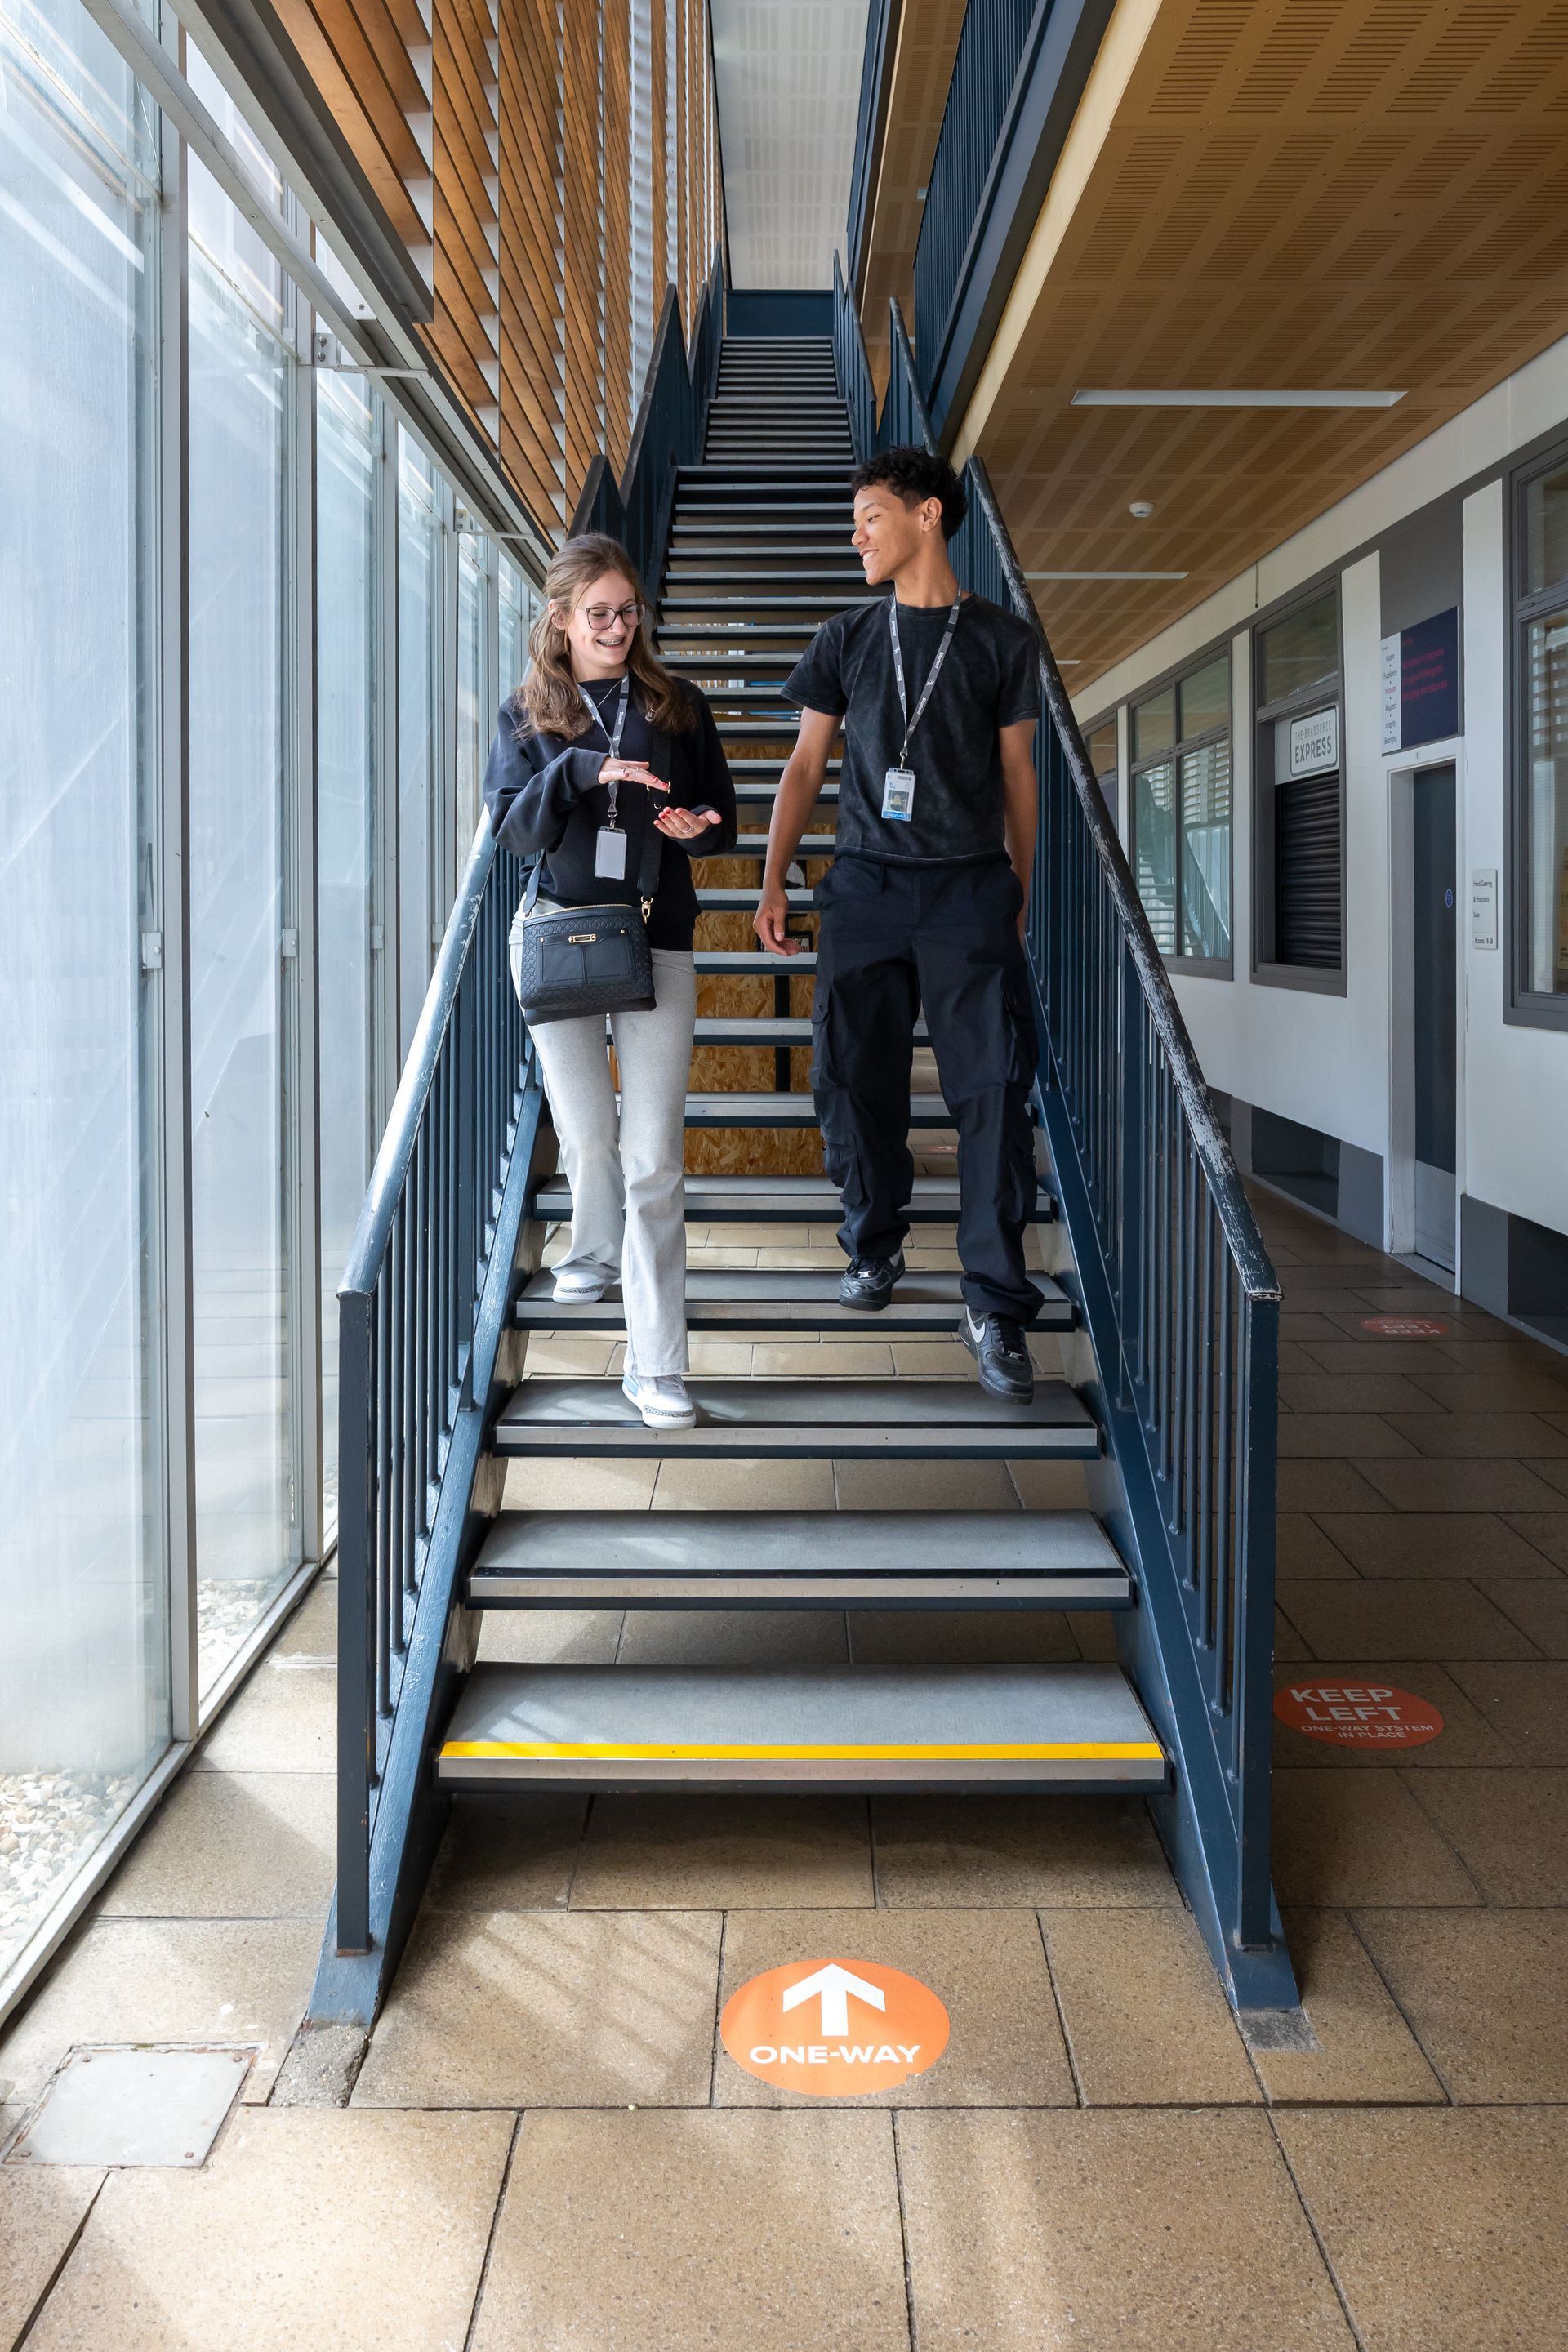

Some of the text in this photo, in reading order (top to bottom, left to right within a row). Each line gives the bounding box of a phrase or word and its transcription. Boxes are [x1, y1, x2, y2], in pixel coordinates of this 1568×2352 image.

[934, 651, 944, 670] Student
[916, 697, 927, 715] Student
[1295, 720, 1332, 741] THE BRASSERIE
[1294, 735, 1332, 764] EXPRESS
[1290, 1688, 1394, 1703] KEEP
[1305, 1707, 1401, 1721] LEFT
[749, 2044, 922, 2065] ONE-WAY
